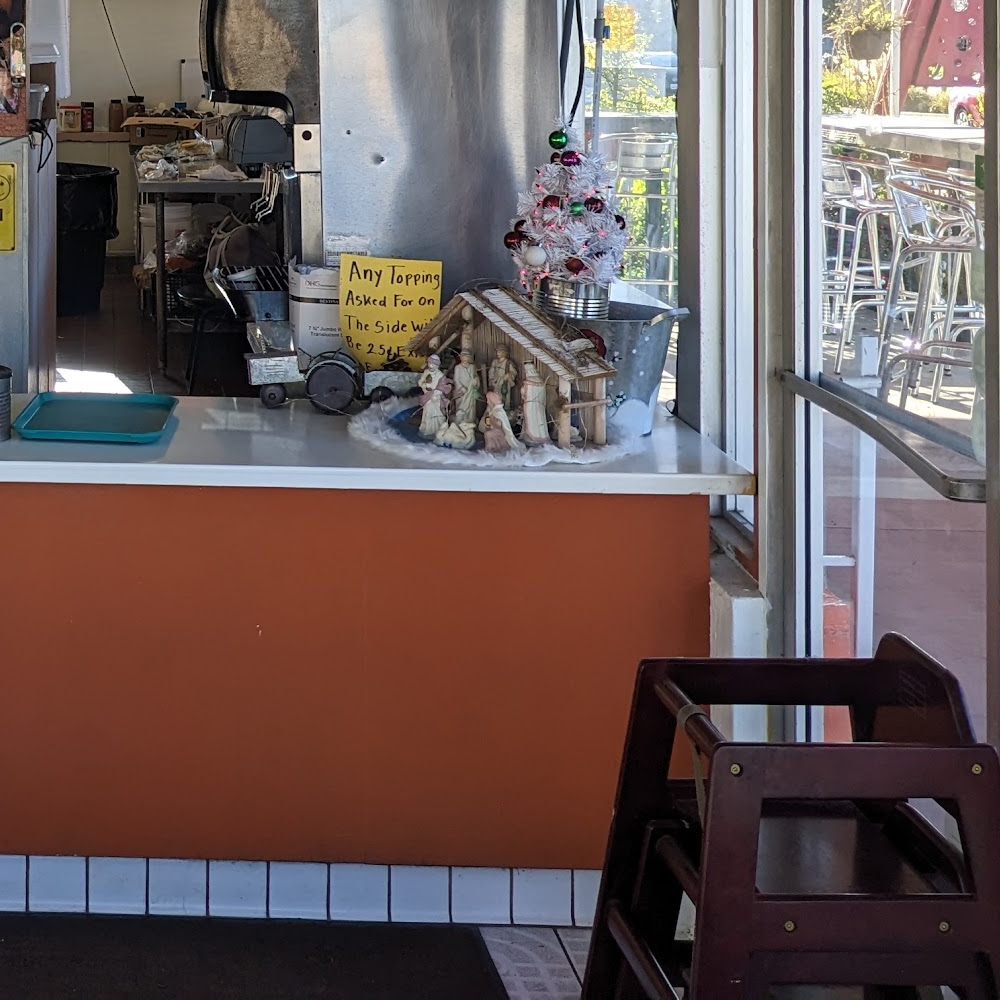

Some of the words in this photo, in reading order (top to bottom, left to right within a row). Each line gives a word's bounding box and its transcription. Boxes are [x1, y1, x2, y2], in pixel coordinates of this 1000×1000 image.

[349, 261, 382, 287] Any
[387, 265, 440, 290] Topping
[346, 290, 386, 307] Asked
[394, 294, 413, 307] For
[344, 314, 369, 331] The
[375, 320, 407, 333] Side
[346, 336, 362, 350] Be
